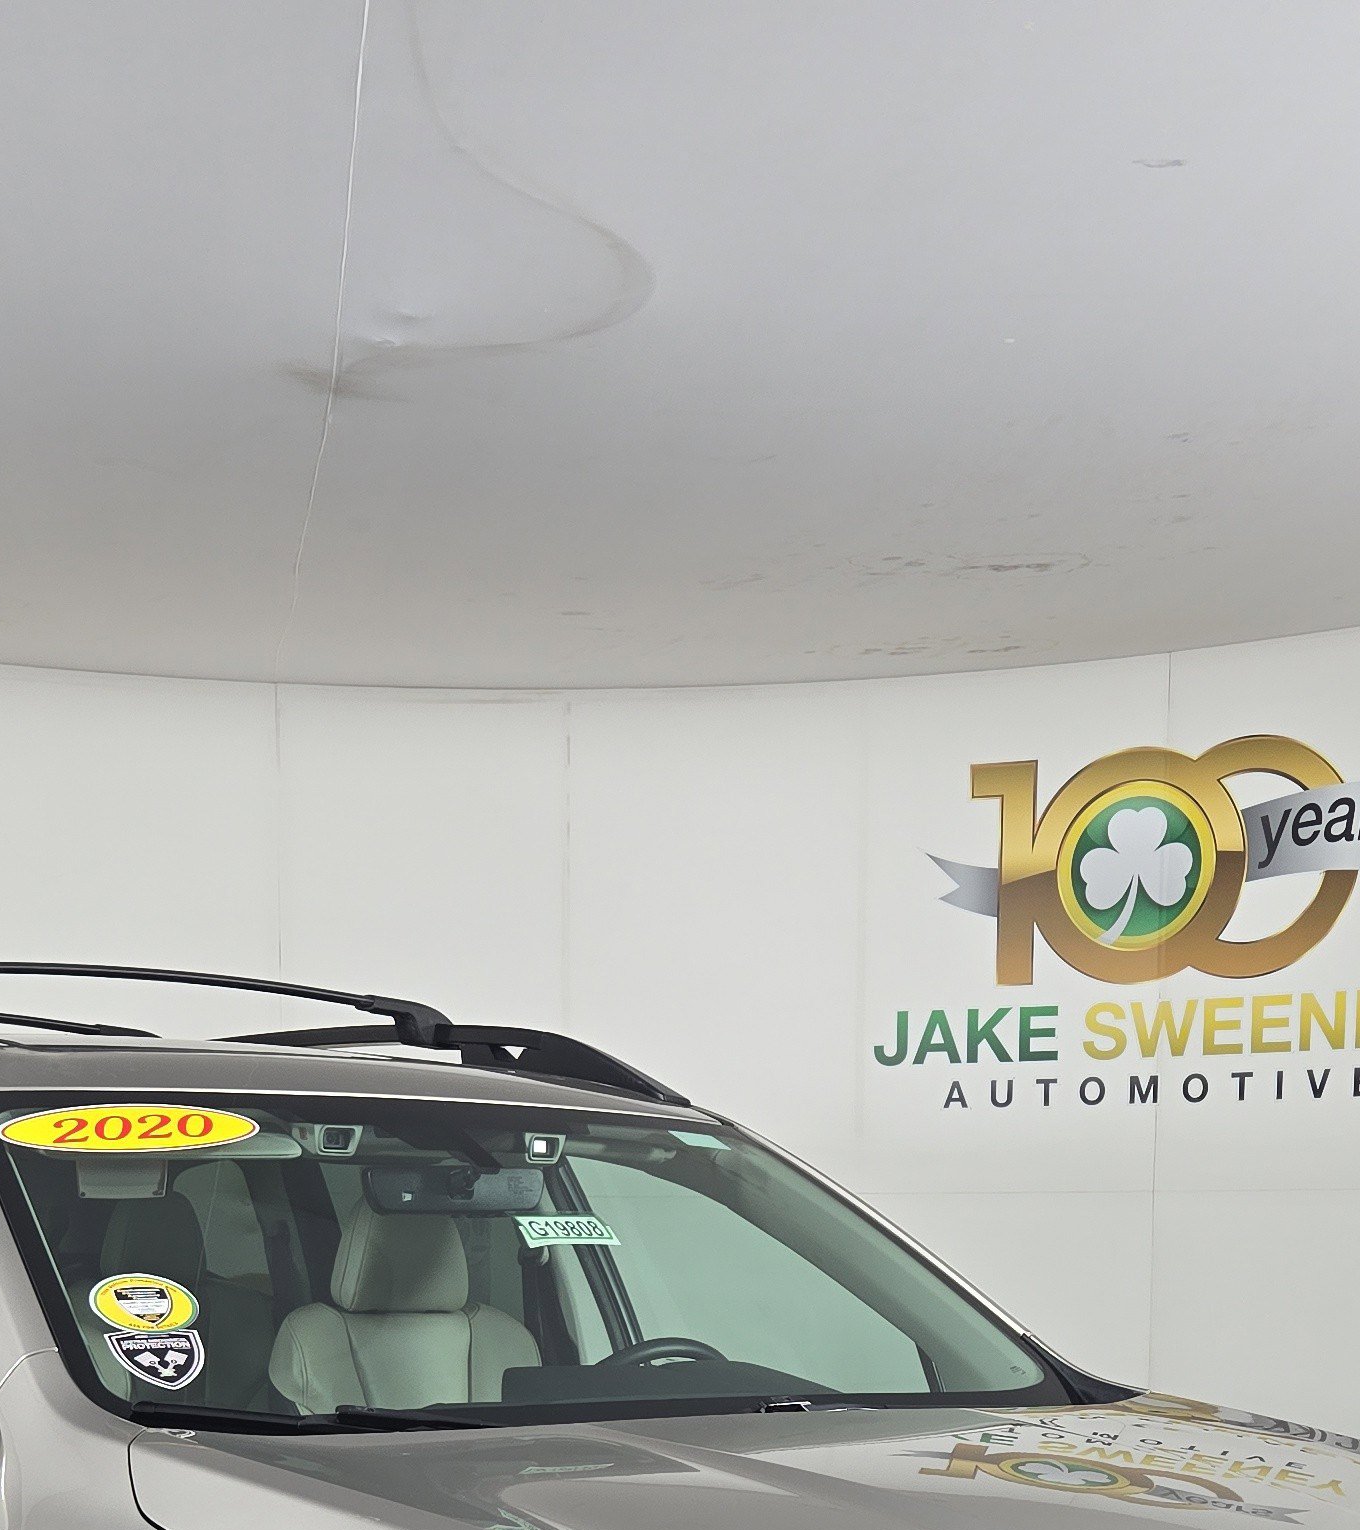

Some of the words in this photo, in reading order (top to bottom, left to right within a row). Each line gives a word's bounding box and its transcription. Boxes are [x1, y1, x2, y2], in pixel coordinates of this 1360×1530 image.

[970, 734, 1357, 986] 100
[874, 1006, 1059, 1066] JAKE
[53, 1114, 213, 1143] 2020
[528, 1220, 604, 1236] G19808
